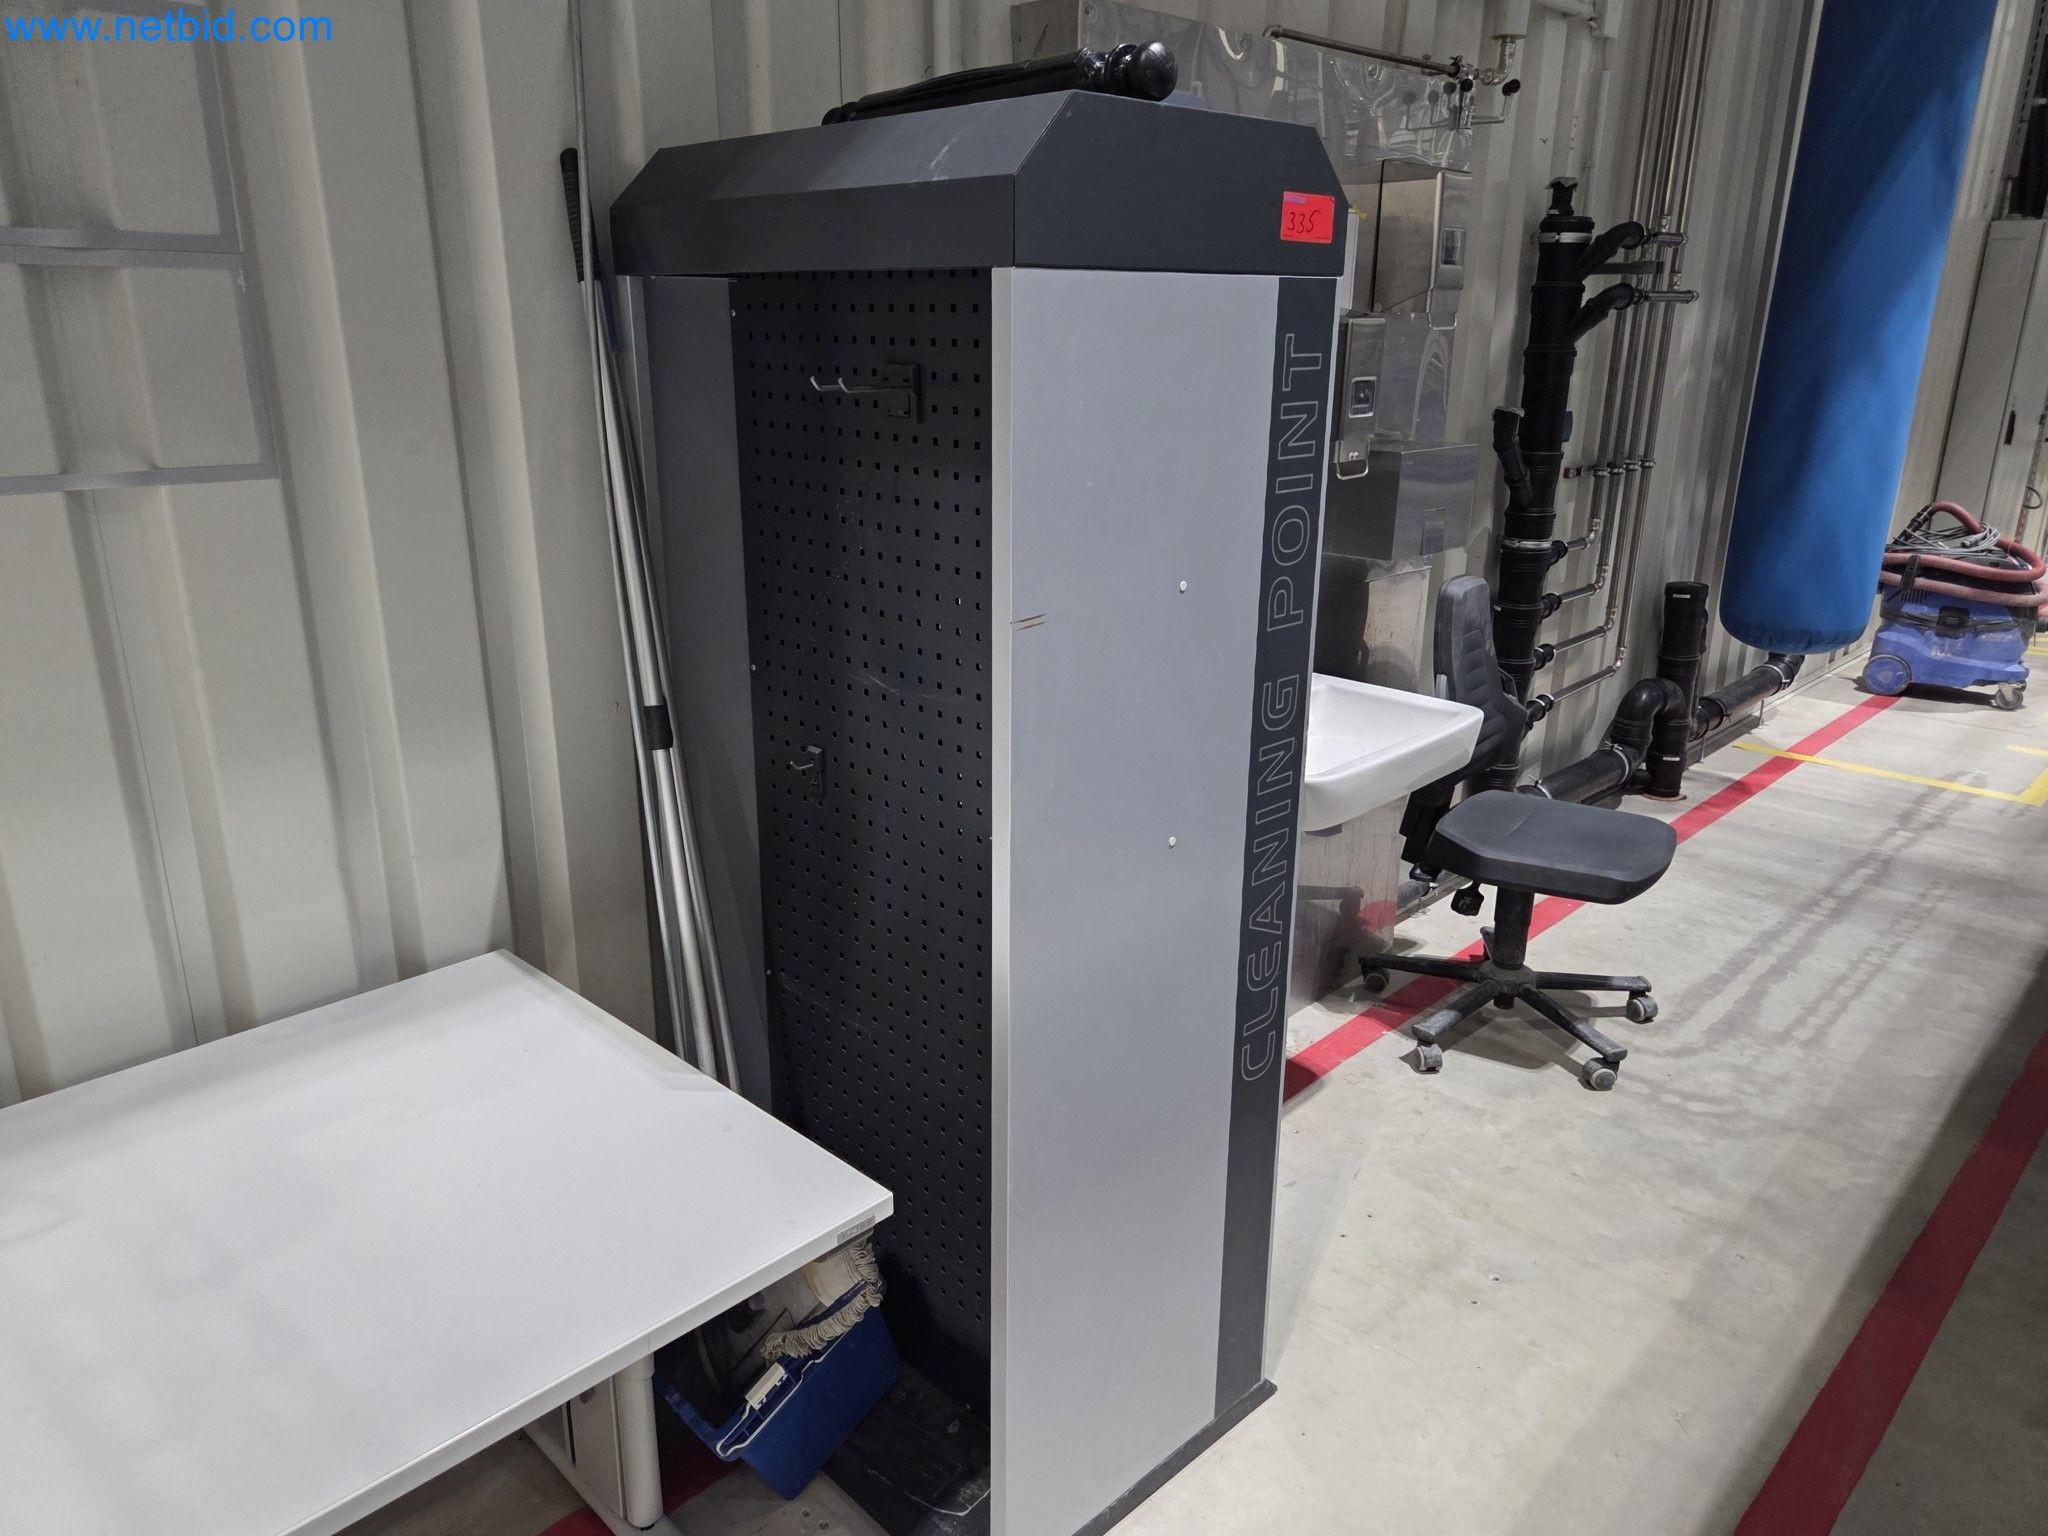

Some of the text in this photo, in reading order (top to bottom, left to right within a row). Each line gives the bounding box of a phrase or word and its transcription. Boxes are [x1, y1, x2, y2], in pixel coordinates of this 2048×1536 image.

[1286, 209, 1322, 234] 335
[1240, 333, 1322, 1082] CLEANING POINT
